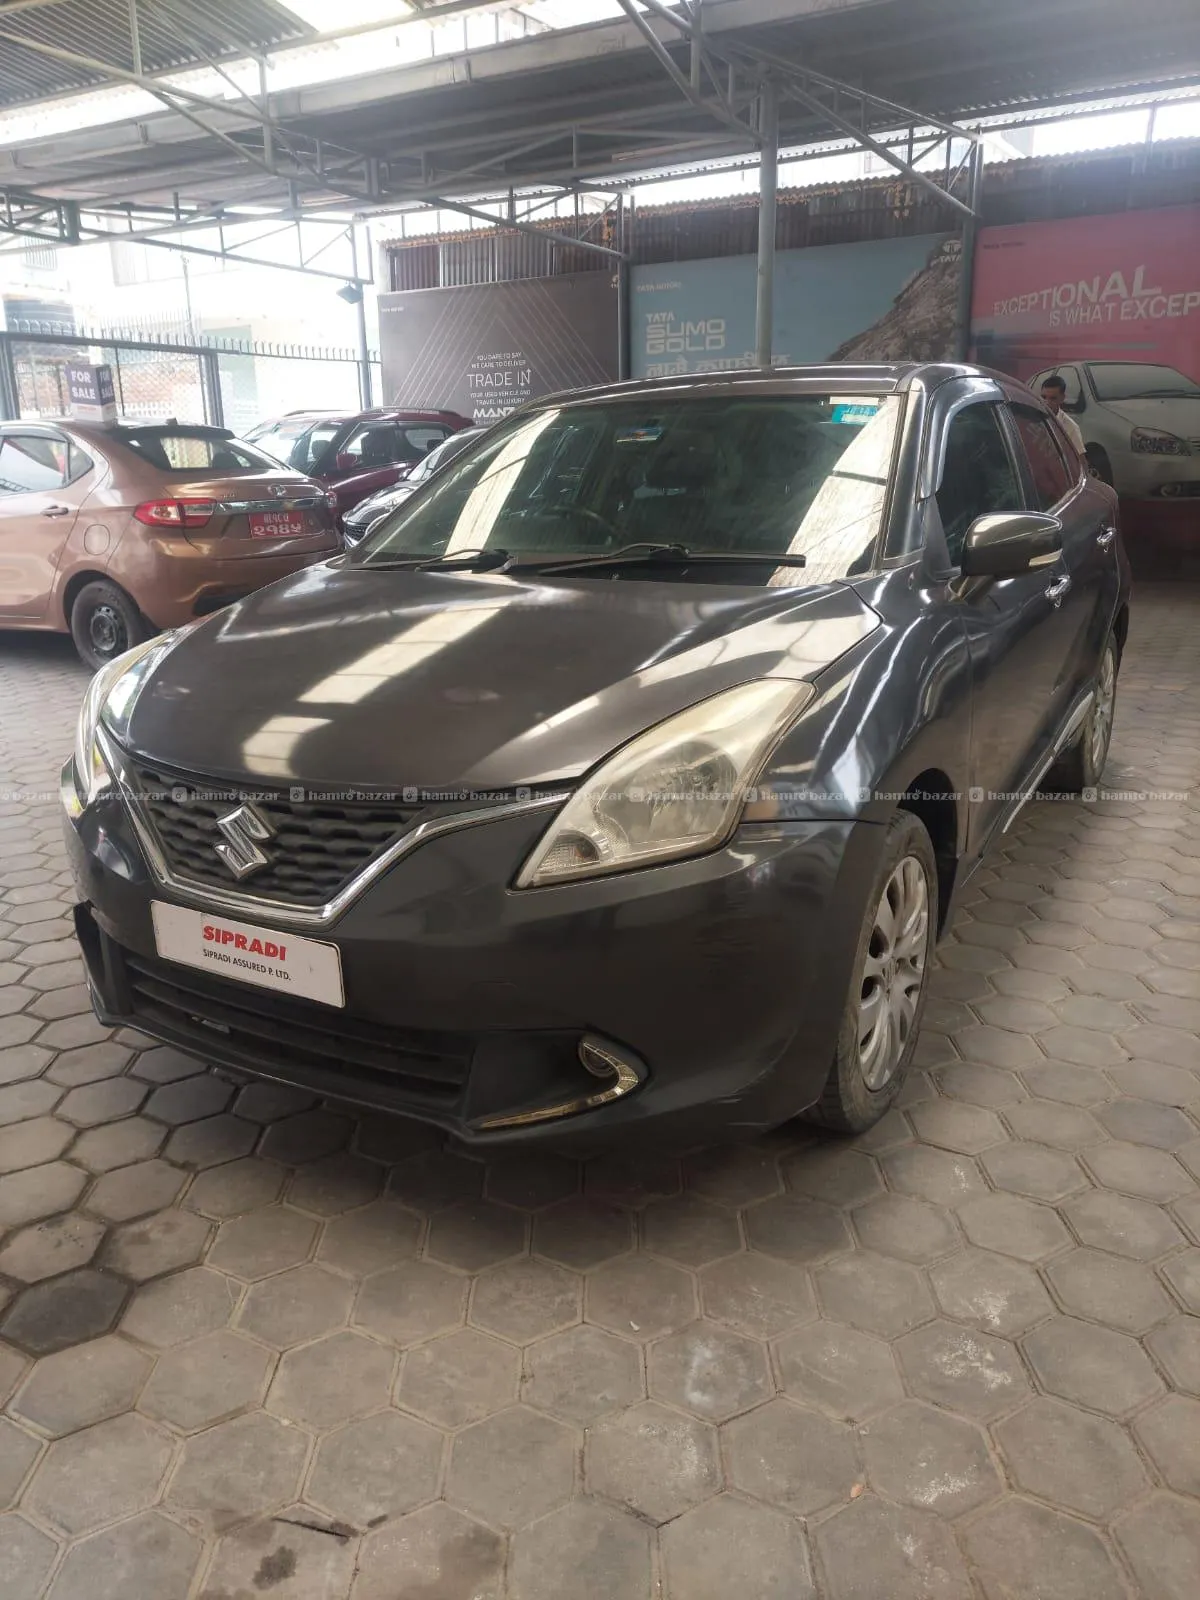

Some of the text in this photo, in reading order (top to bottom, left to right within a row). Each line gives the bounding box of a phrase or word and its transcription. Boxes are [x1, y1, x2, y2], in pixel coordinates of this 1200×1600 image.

[993, 264, 1163, 316] EXCEPTIONAL
[645, 311, 675, 323] TATA
[1049, 291, 1200, 327] IS WHAT EXCEP
[645, 318, 726, 339] SUMO
[645, 334, 726, 354] GOLD
[71, 370, 92, 384] FOR
[466, 368, 531, 388] TRADE IN
[72, 386, 97, 400] SALE
[203, 925, 287, 961] SIPRADI
[203, 948, 292, 981] SIPRADI ASSURED P. LTD.
